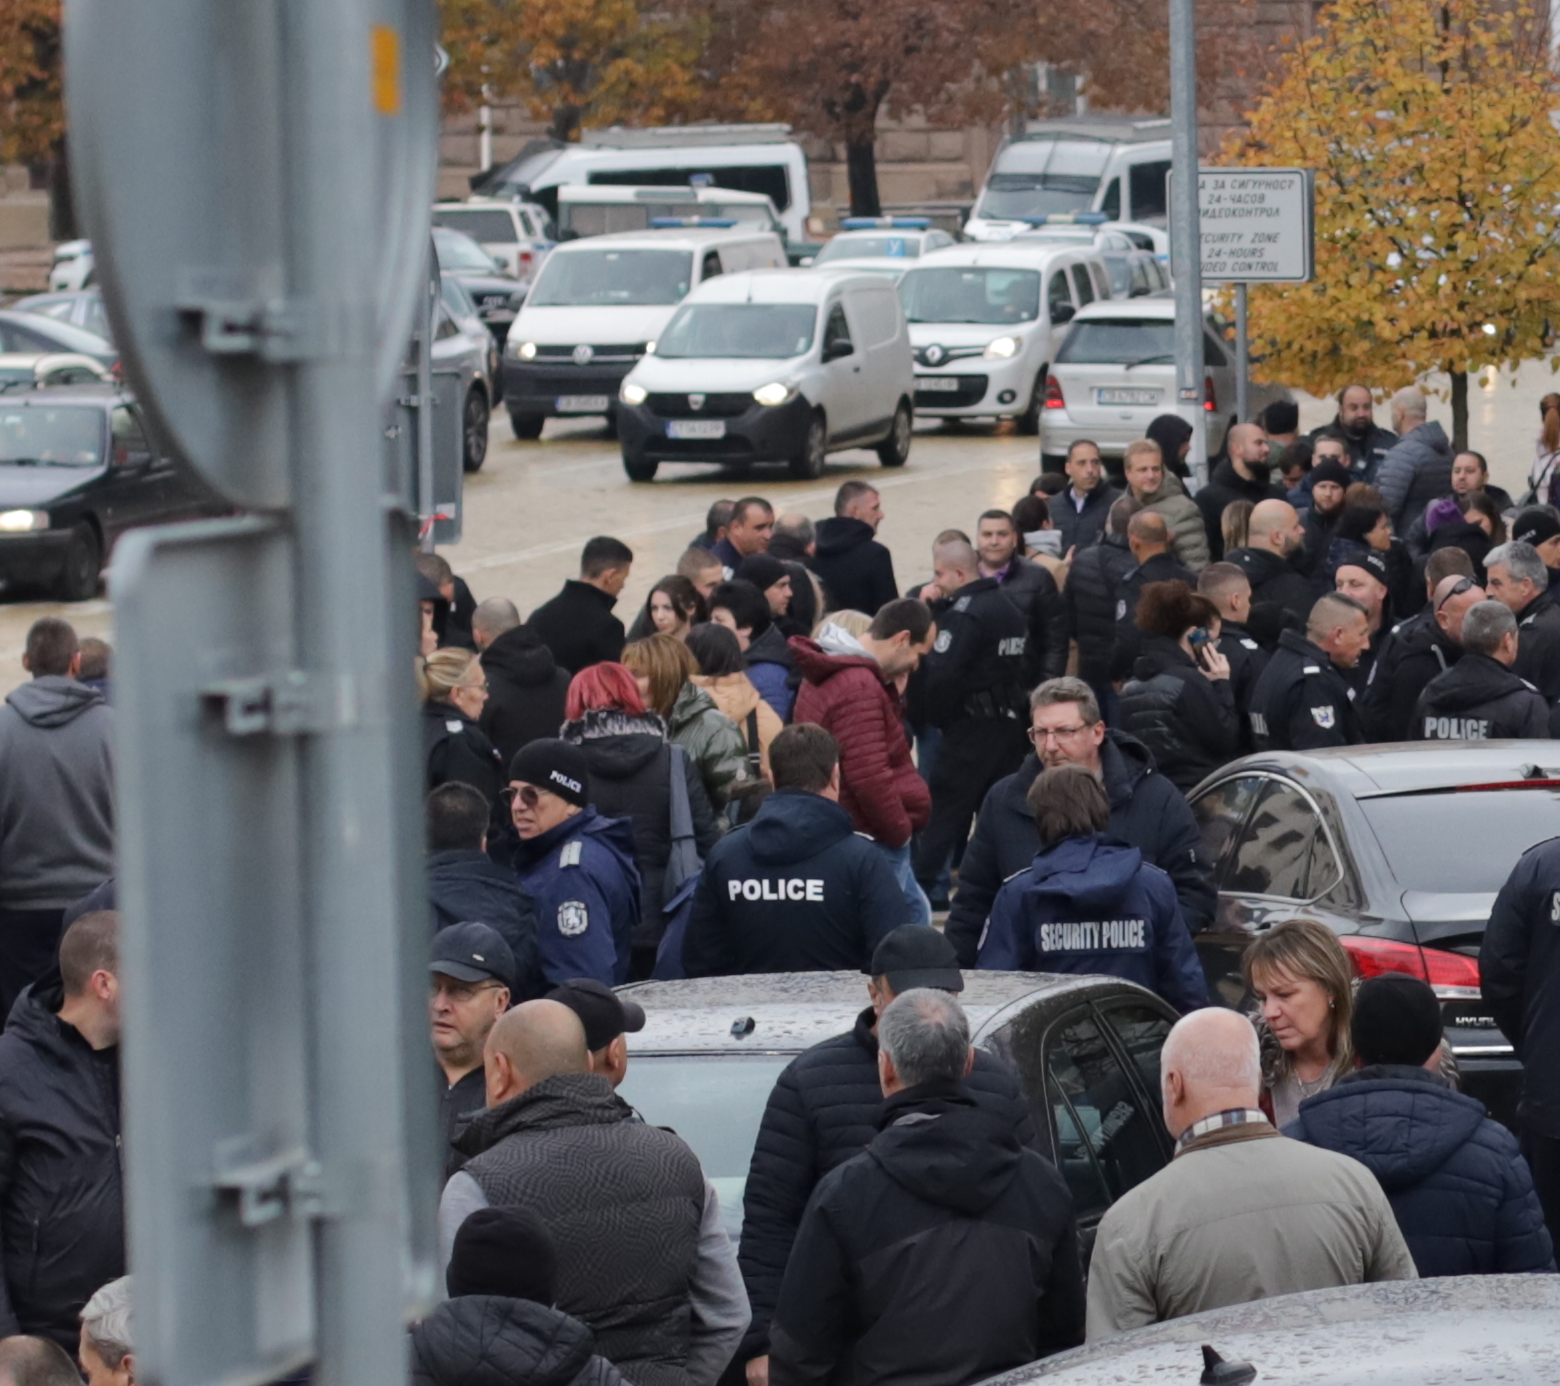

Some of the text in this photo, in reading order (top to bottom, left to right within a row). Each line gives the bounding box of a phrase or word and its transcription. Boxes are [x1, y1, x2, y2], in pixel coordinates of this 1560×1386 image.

[1213, 179, 1225, 190] ЗА
[1207, 194, 1266, 205] 24-ЧАСОВ
[1250, 232, 1281, 244] ZONE
[1207, 247, 1266, 259] 24-HOURS
[1200, 261, 1279, 273] IDEO CONTROL
[1424, 716, 1488, 741] POLICE
[728, 878, 824, 901] POLICE
[1040, 919, 1145, 952] SECURITY POLICE
